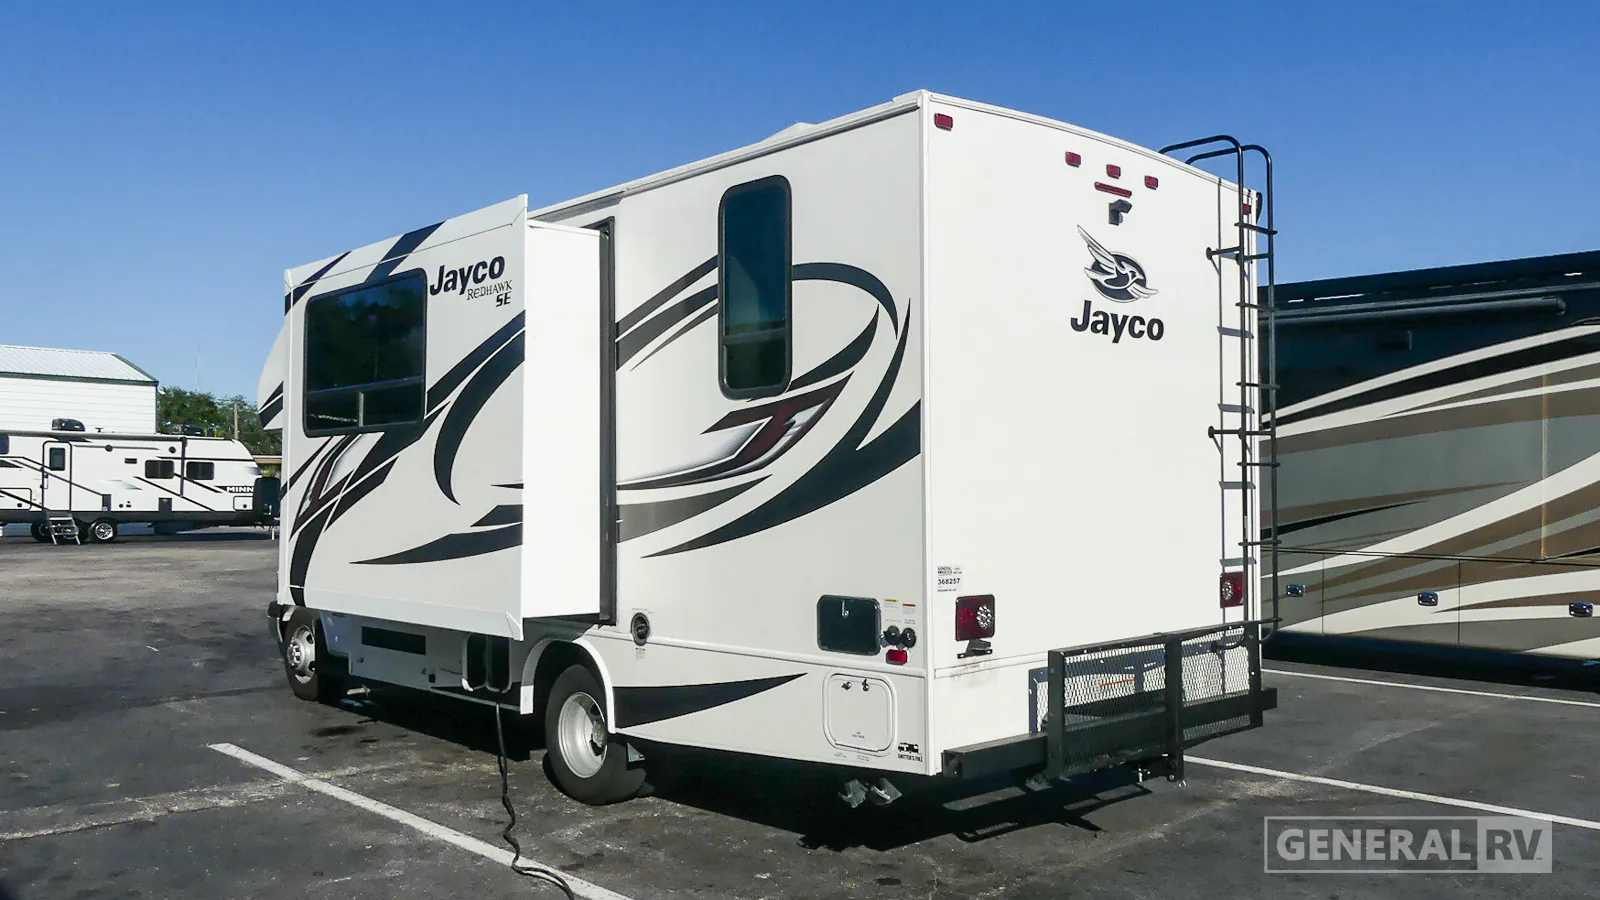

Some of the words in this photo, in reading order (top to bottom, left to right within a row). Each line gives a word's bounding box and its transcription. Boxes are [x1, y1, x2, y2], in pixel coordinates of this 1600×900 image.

[429, 256, 505, 296] Jayco
[495, 292, 512, 307] SE
[1070, 299, 1165, 344] Jayco
